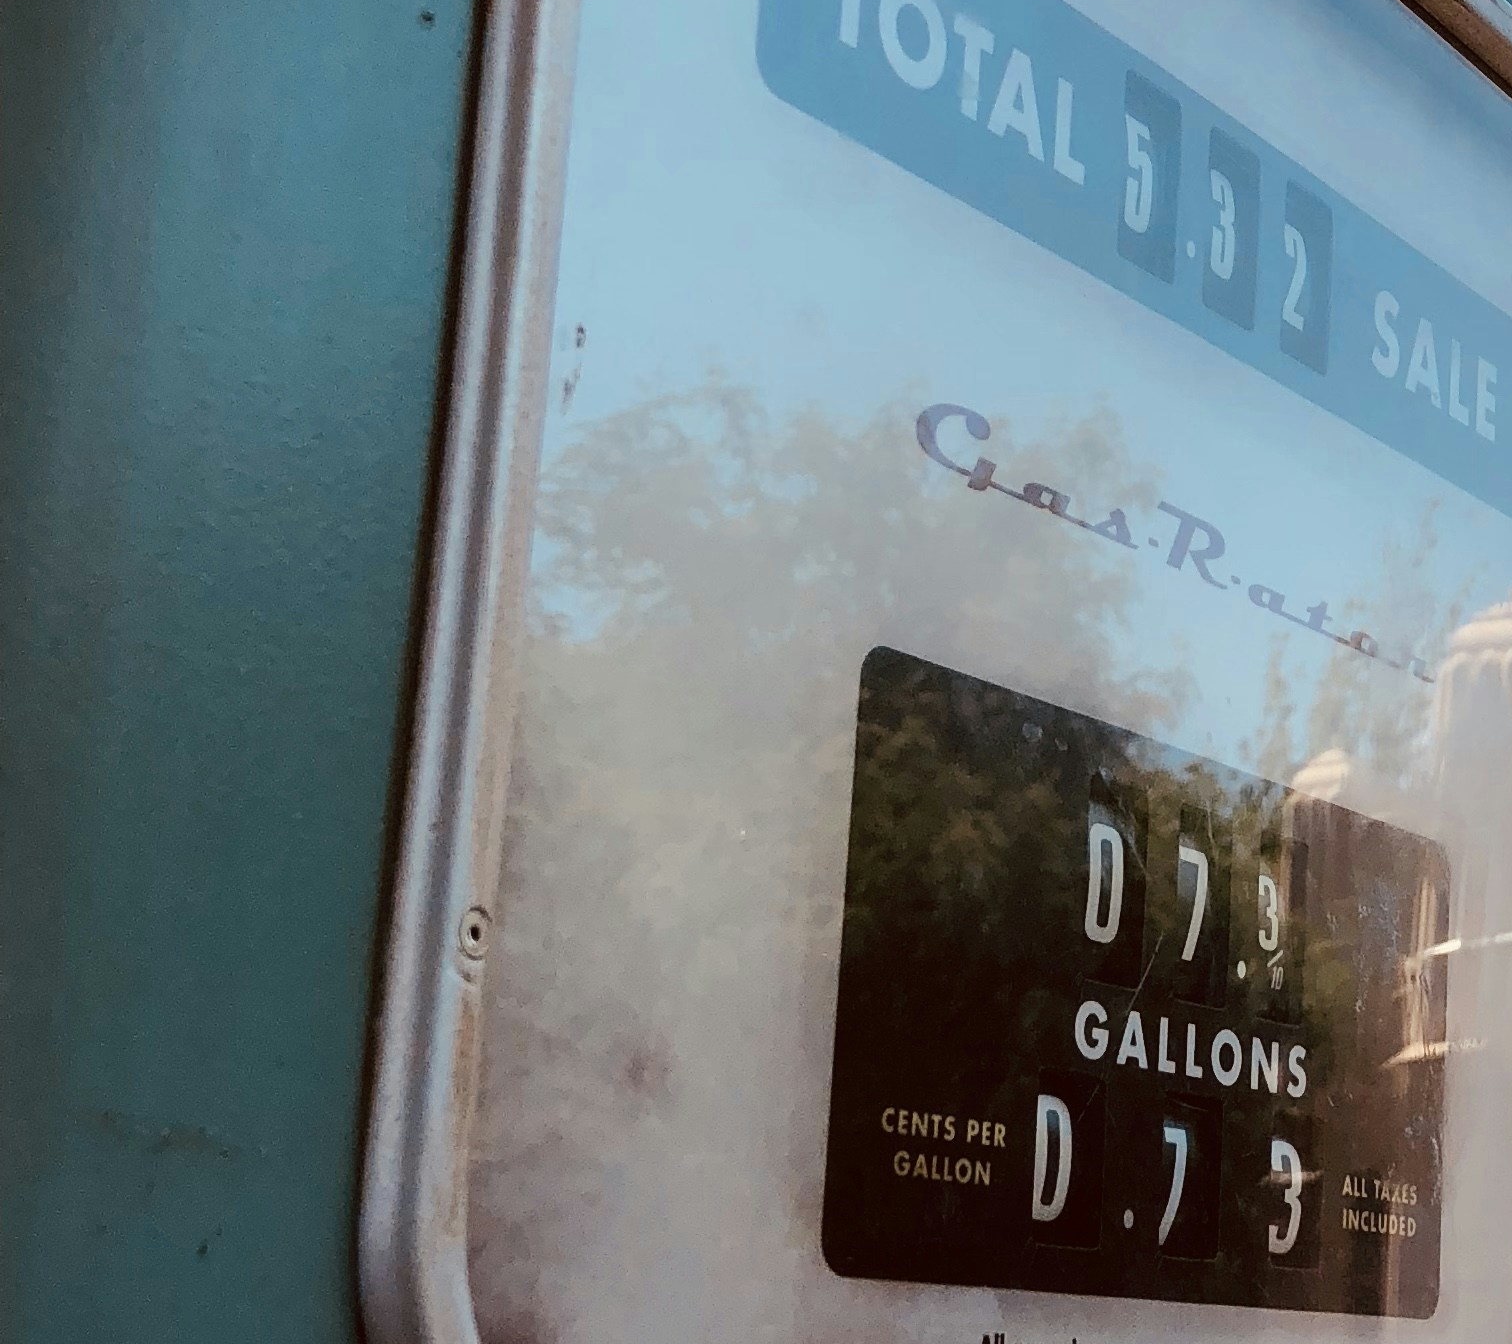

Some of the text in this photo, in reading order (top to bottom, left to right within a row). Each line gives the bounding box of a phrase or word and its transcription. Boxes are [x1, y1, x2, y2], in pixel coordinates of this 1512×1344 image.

[1371, 289, 1497, 443] SALE
[1075, 1000, 1307, 1098] GALLONS
[881, 1107, 1006, 1148] CENTS PER
[893, 1150, 991, 1186] GALLON
[1342, 1174, 1418, 1206] ALL TAXES
[1342, 1207, 1417, 1237] INCLUDED
